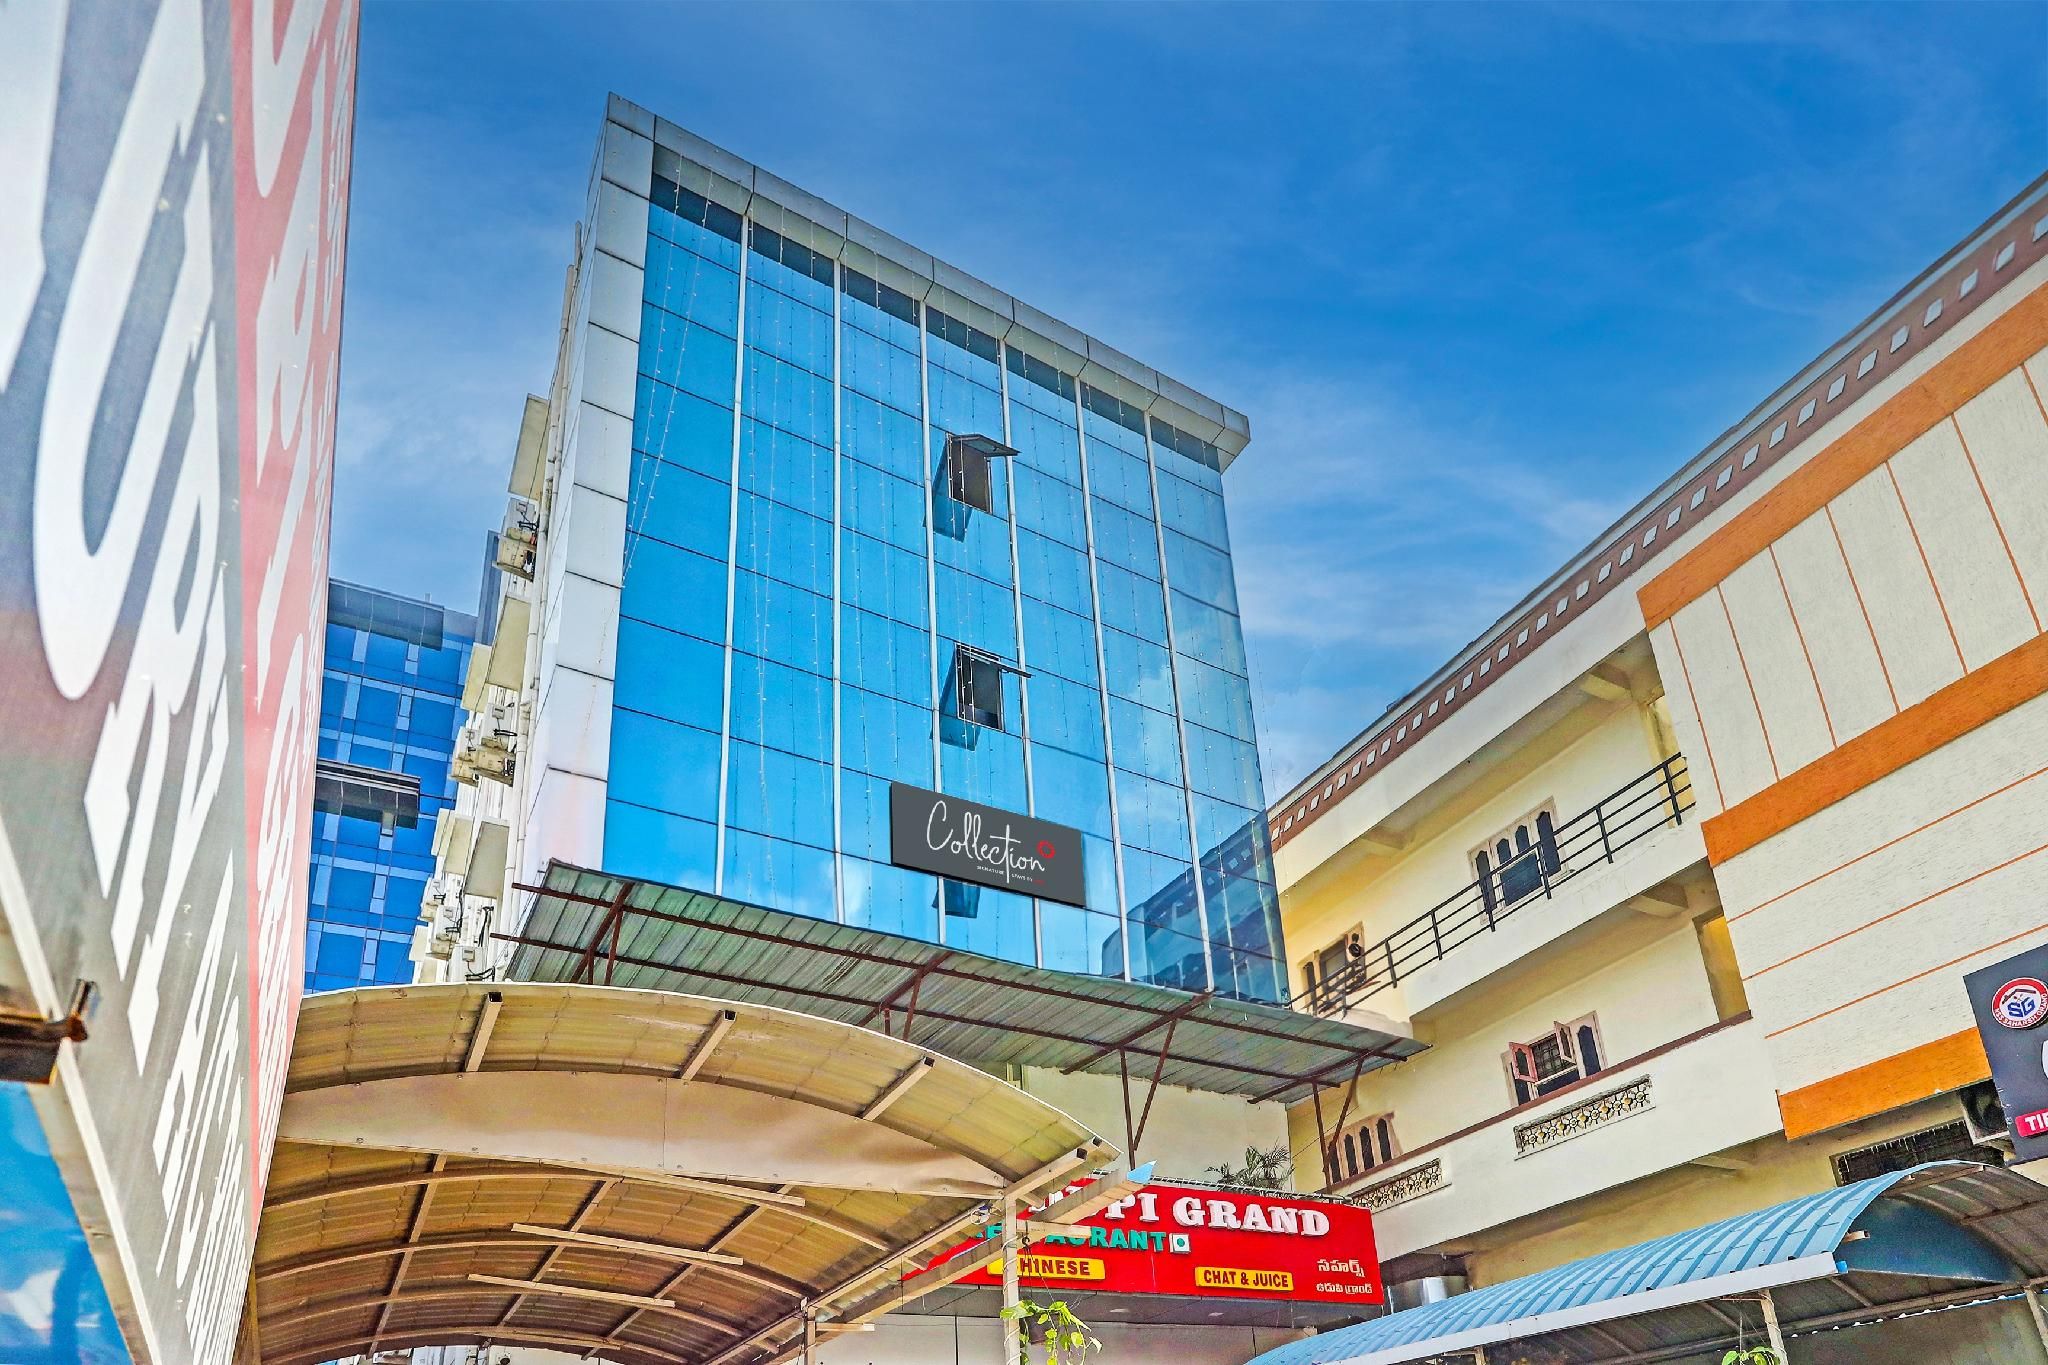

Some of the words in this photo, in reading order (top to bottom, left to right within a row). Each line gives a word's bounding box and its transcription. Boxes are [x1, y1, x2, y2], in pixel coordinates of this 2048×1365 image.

[927, 800, 1045, 884] Collection
[2007, 996, 2036, 1018] SG
[1173, 1196, 1330, 1237] GRAND
[1018, 1258, 1091, 1277] HINESE
[1203, 1269, 1236, 1285] CHAT
[1240, 1272, 1249, 1286] &
[1253, 1273, 1289, 1288] JUICE
